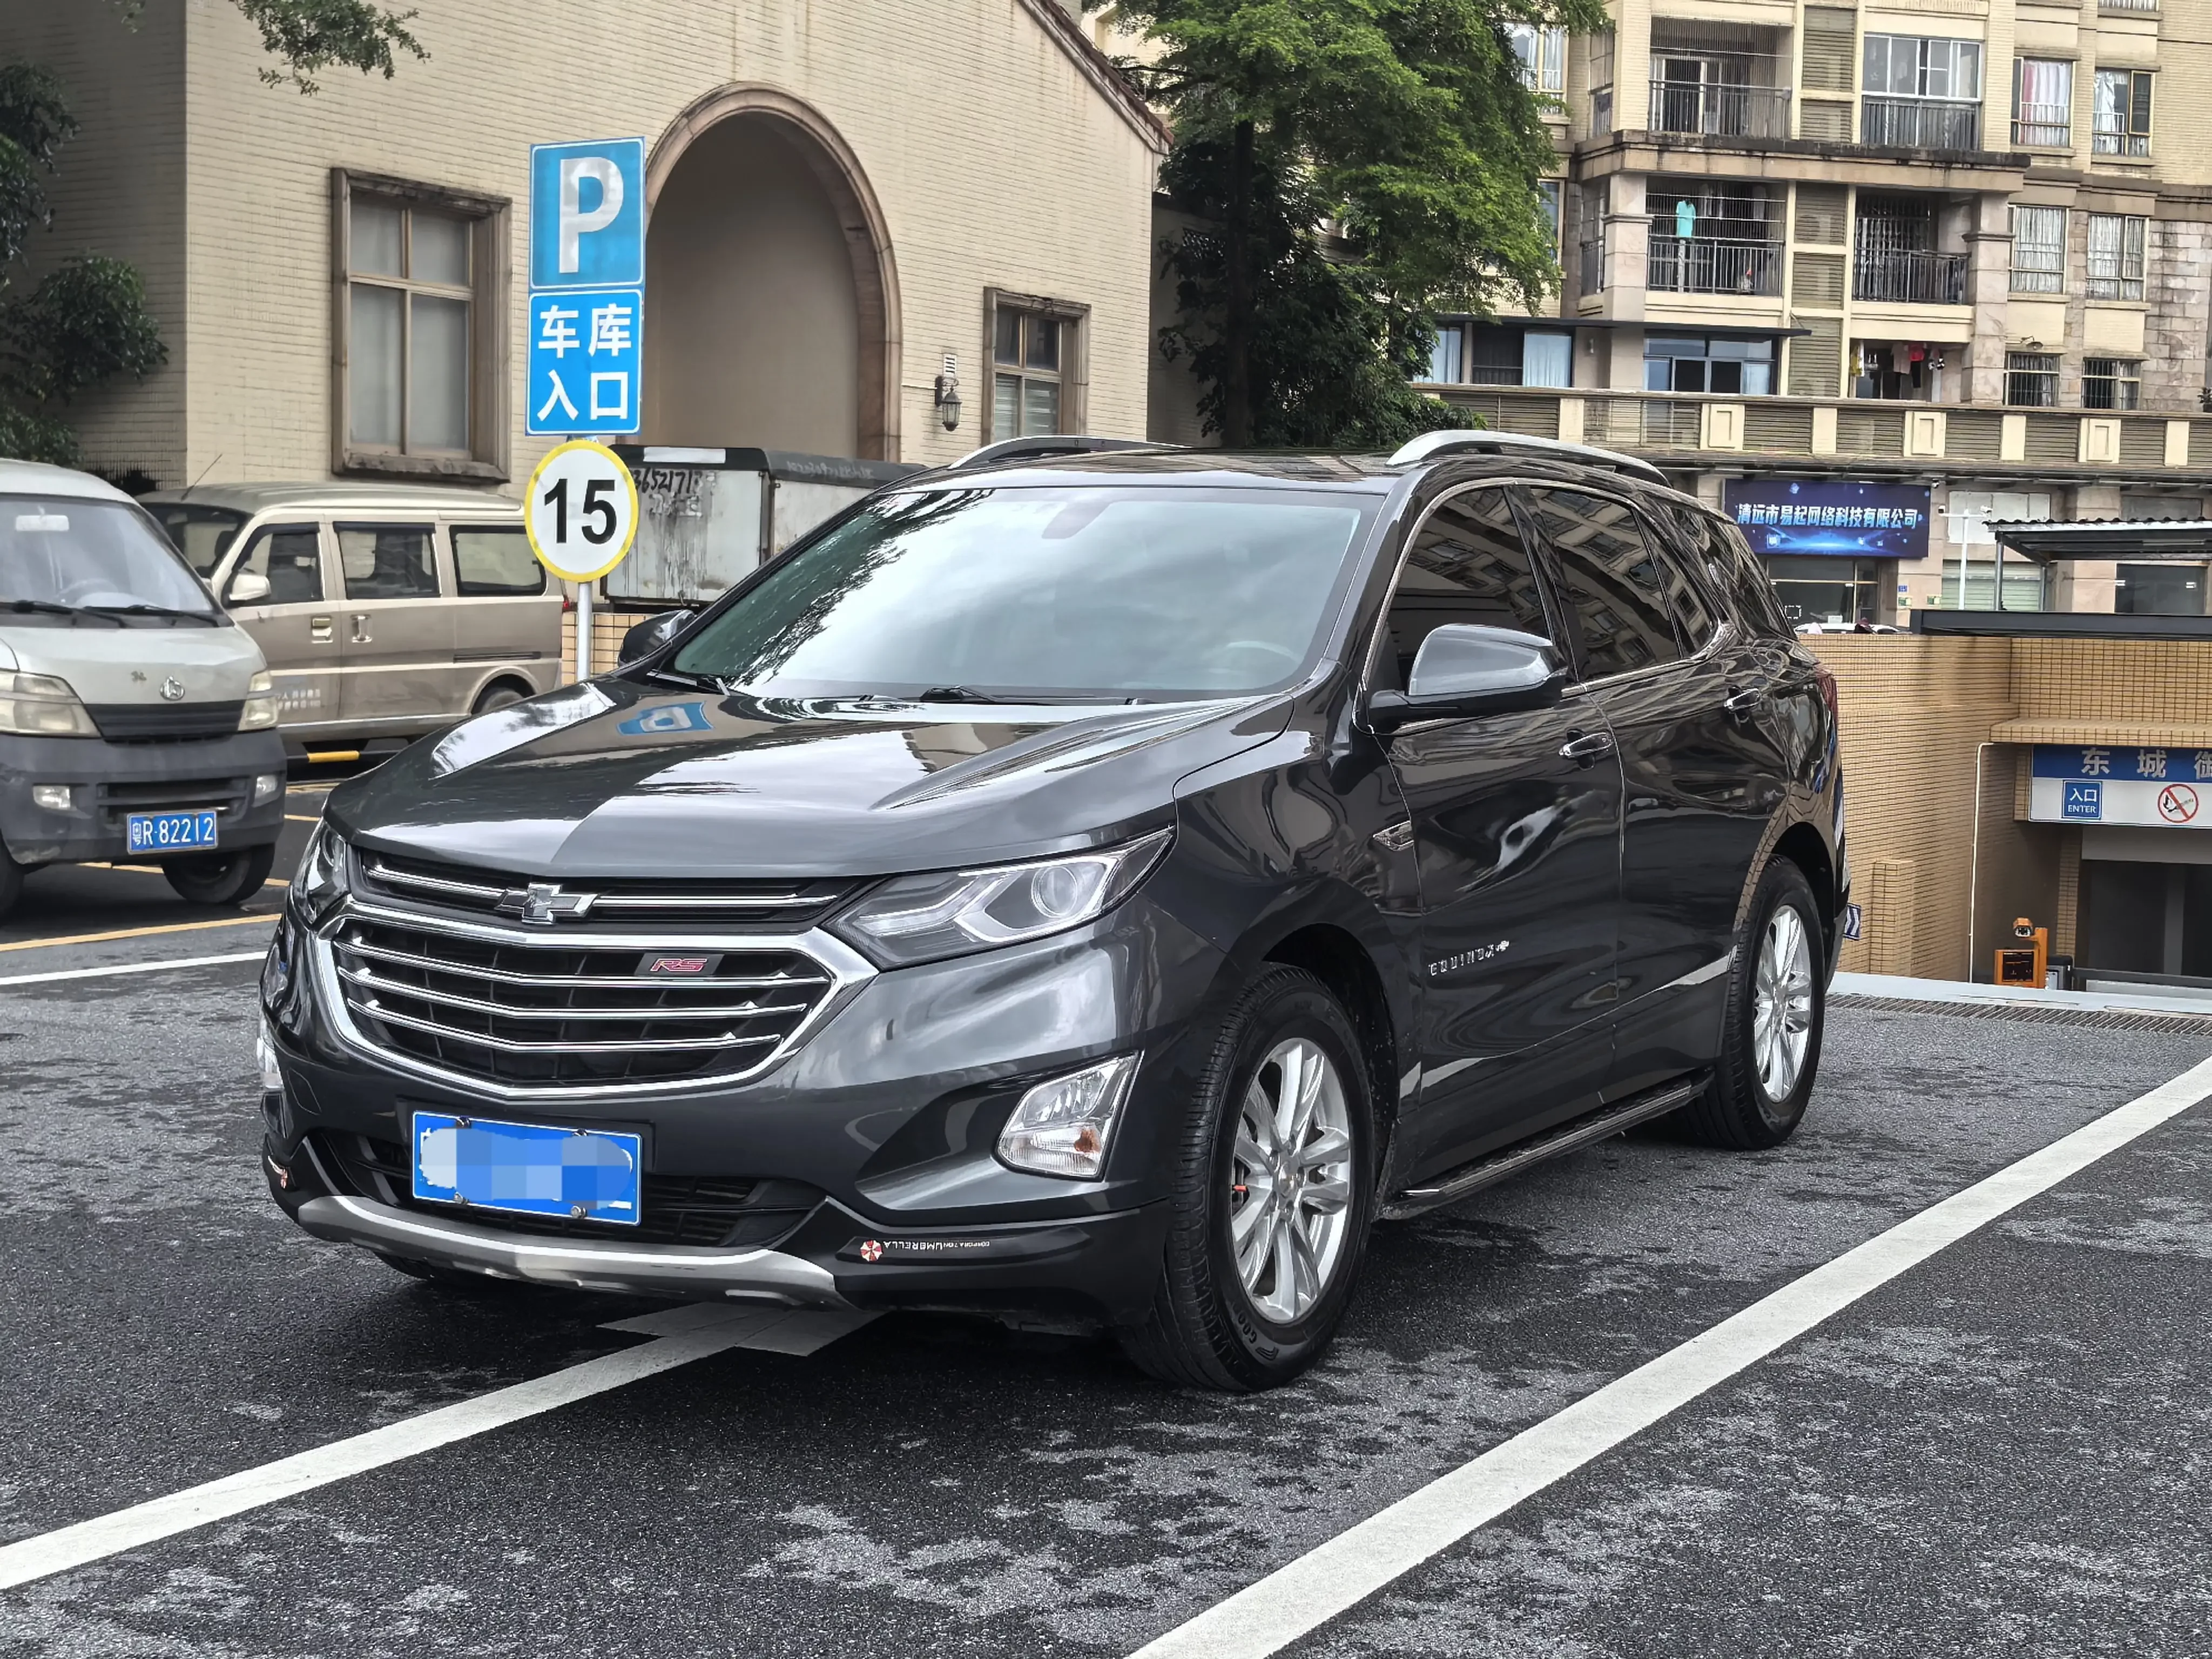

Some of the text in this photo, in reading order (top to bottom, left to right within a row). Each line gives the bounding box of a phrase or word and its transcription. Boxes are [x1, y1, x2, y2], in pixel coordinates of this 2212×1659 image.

[558, 156, 624, 274] P
[537, 303, 633, 359] 车库
[536, 369, 629, 422] 入口
[543, 477, 618, 545] 15
[1737, 503, 1918, 529] 清远市易起网络科技有限公司
[2068, 804, 2096, 814] ENTER
[2069, 788, 2098, 802] 入口
[650, 958, 707, 972] RS
